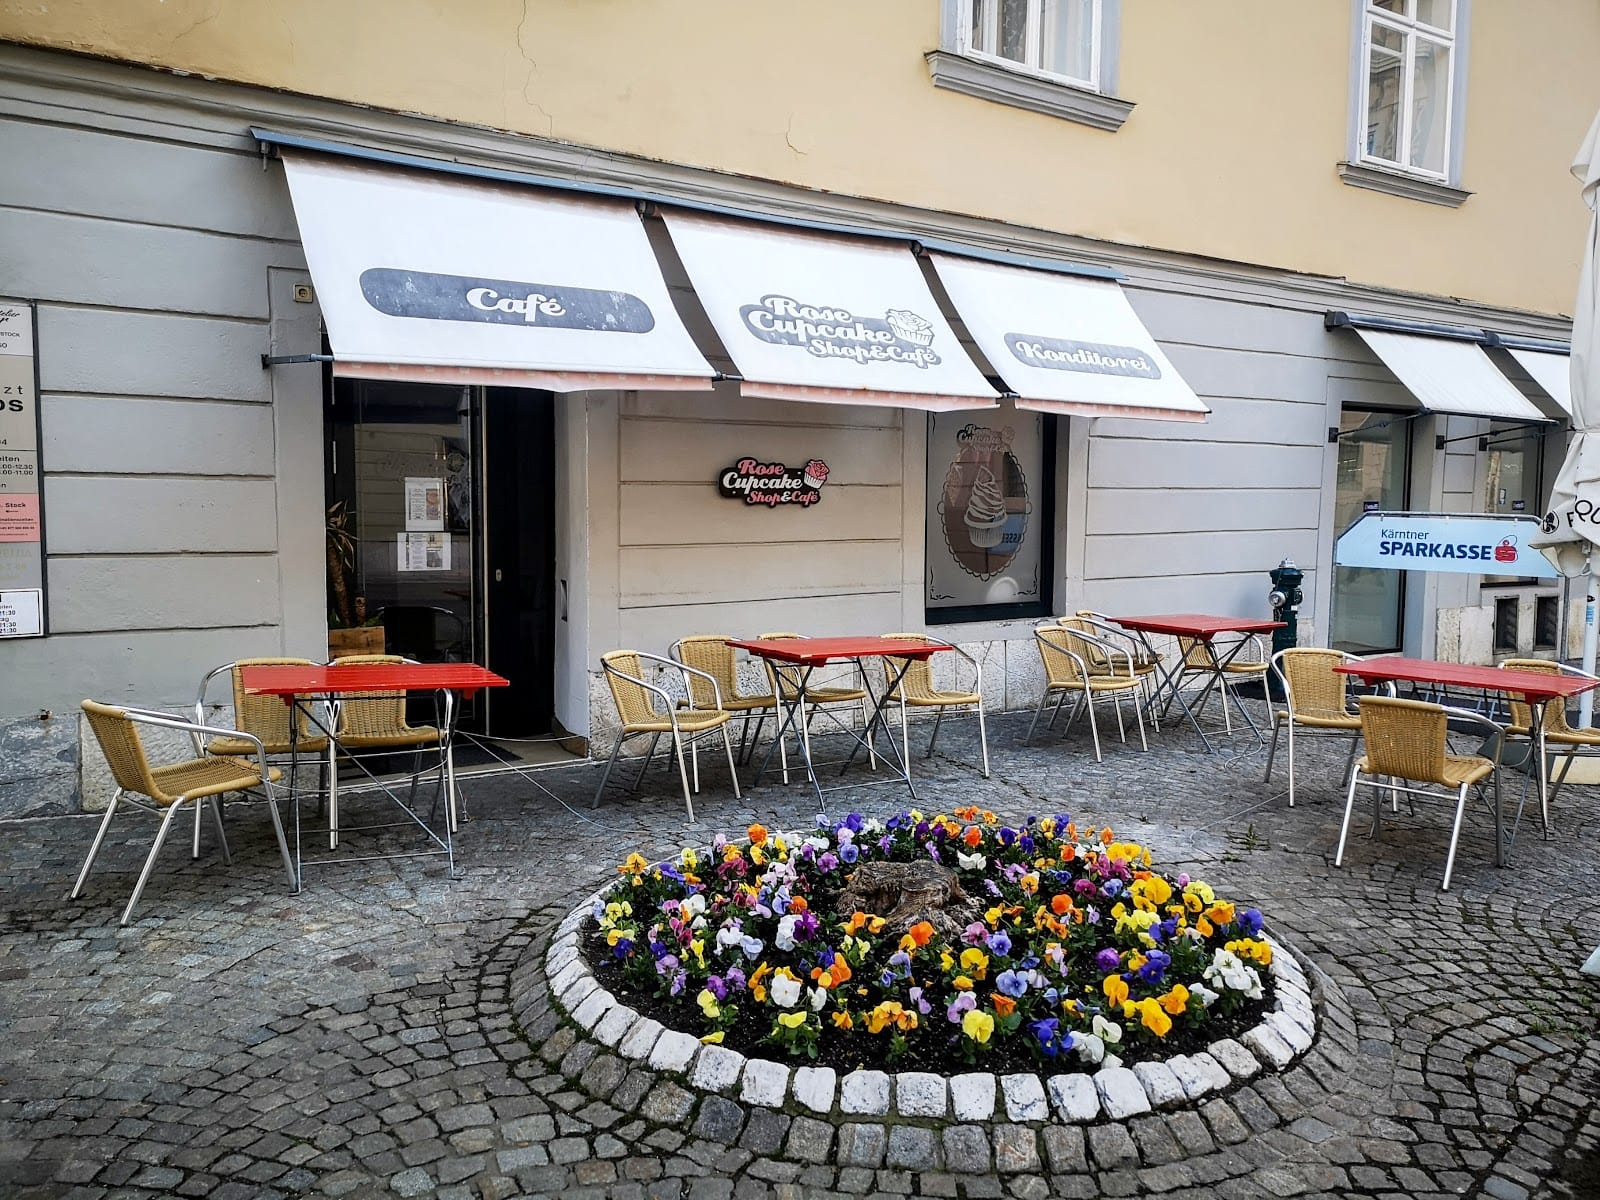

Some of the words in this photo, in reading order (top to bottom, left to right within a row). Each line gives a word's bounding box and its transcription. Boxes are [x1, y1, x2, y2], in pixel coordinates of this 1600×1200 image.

[466, 287, 566, 322] Café
[763, 297, 852, 323] Rose
[749, 310, 895, 343] Cupcake
[1015, 341, 1150, 371] Konditorei
[737, 459, 785, 475] Rose
[722, 472, 803, 494] Cupcake
[1381, 529, 1429, 540] Kärntner
[1379, 541, 1492, 560] SPARKASSE
